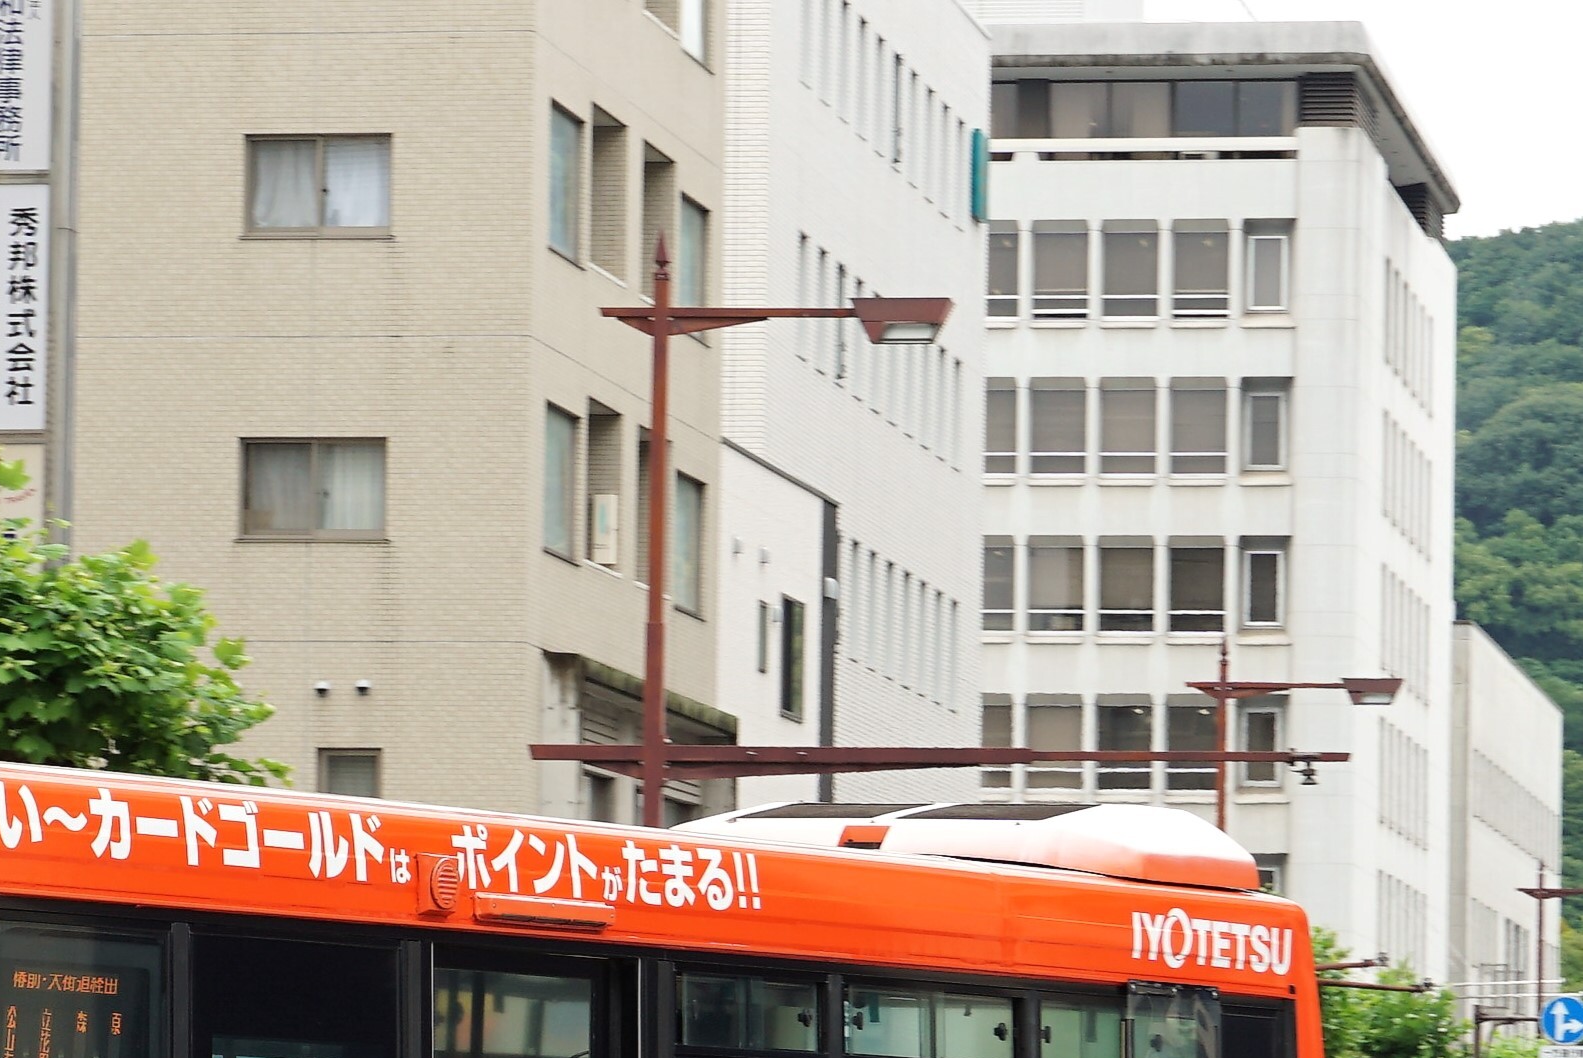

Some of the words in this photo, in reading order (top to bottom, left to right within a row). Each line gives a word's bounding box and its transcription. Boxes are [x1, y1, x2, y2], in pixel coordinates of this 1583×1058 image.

[5, 207, 39, 406] 秀邦株式会社
[1131, 908, 1293, 975] IYOTETSU
